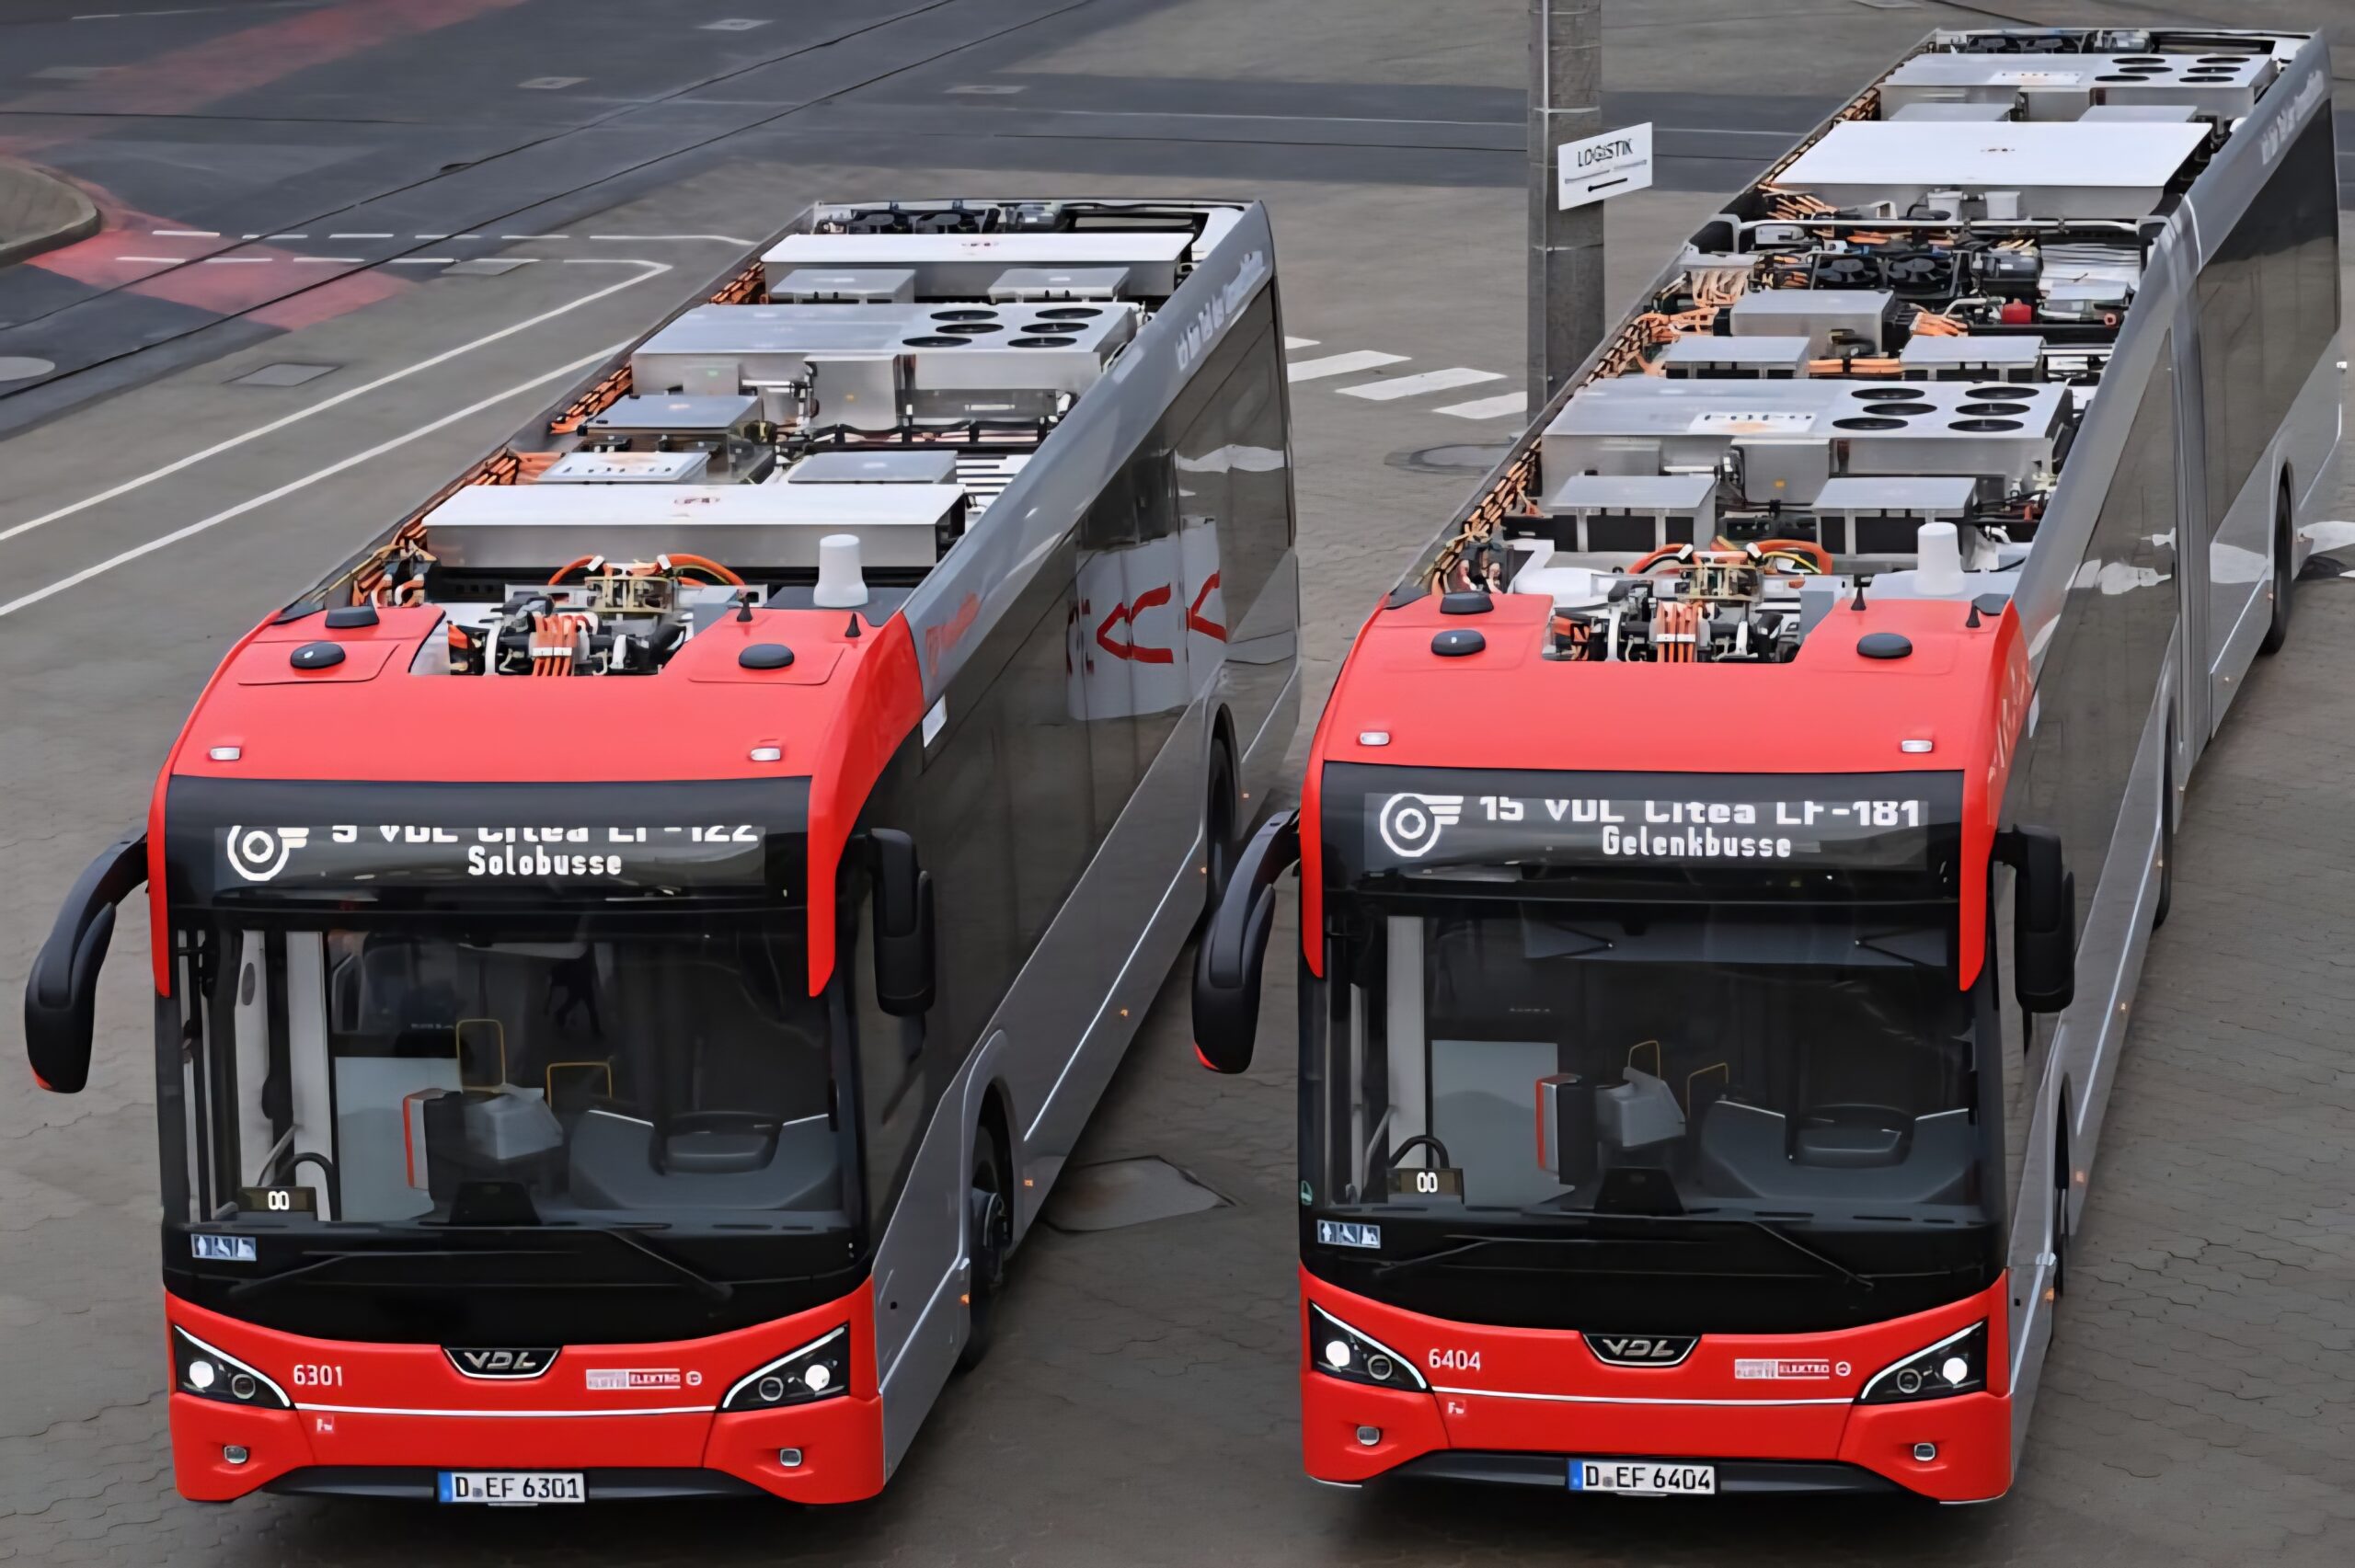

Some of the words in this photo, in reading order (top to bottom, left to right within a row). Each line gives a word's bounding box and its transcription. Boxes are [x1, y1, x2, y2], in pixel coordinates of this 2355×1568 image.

[1480, 795, 1523, 820] 15
[1545, 799, 1626, 822] VDL
[1646, 800, 1755, 823] Citea
[1776, 799, 1918, 827] LF-181
[1603, 825, 1791, 858] Gelenkbusse
[467, 844, 622, 876] Solobusse
[1429, 1347, 1481, 1372] 6404
[1603, 1338, 1674, 1357] VDL
[464, 1351, 536, 1370] VDL
[293, 1364, 343, 1387] 6301
[455, 1475, 469, 1498] D
[486, 1477, 515, 1498] EF
[523, 1477, 580, 1499] 6301
[1586, 1465, 1599, 1487] D
[1616, 1466, 1646, 1488] EF
[1653, 1467, 1711, 1491] 6404
